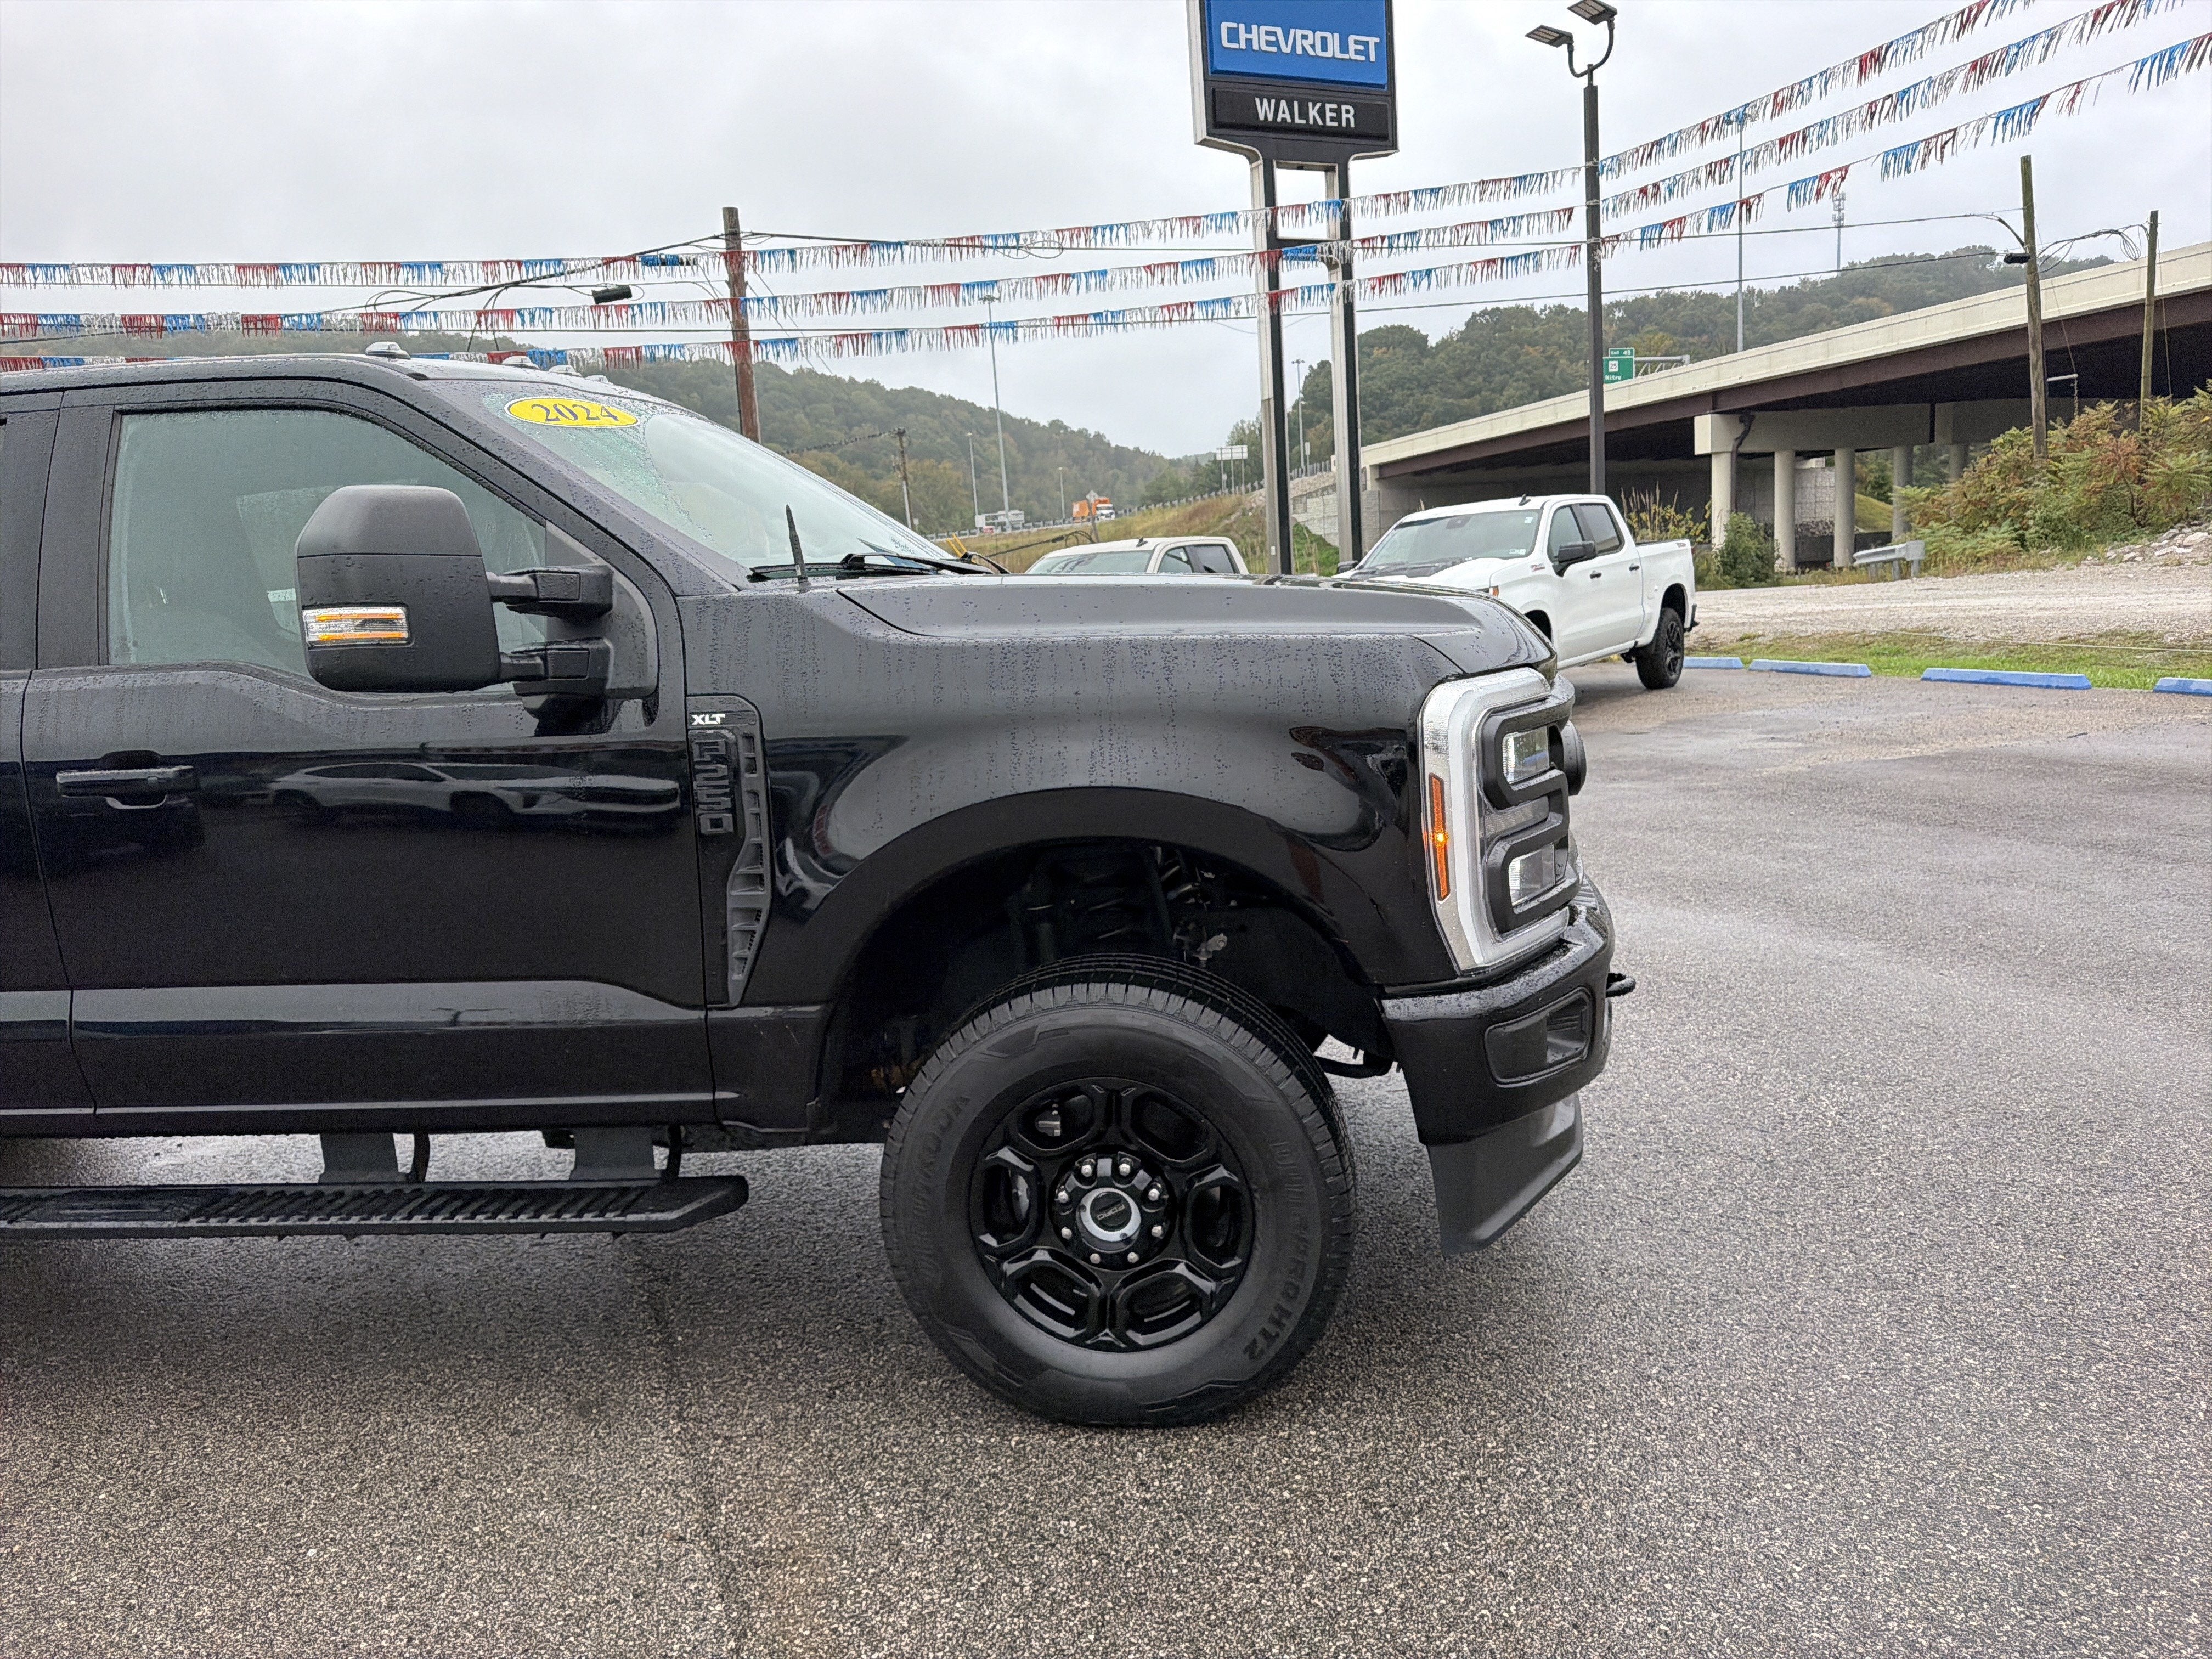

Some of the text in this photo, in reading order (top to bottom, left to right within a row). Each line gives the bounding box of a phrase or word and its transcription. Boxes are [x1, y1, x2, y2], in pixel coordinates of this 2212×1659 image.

[1220, 21, 1380, 63] CHEVROLET
[1254, 97, 1356, 128] WALKER
[531, 403, 620, 422] 2024
[691, 713, 726, 725] XLT
[1097, 1204, 1125, 1221] FORD
